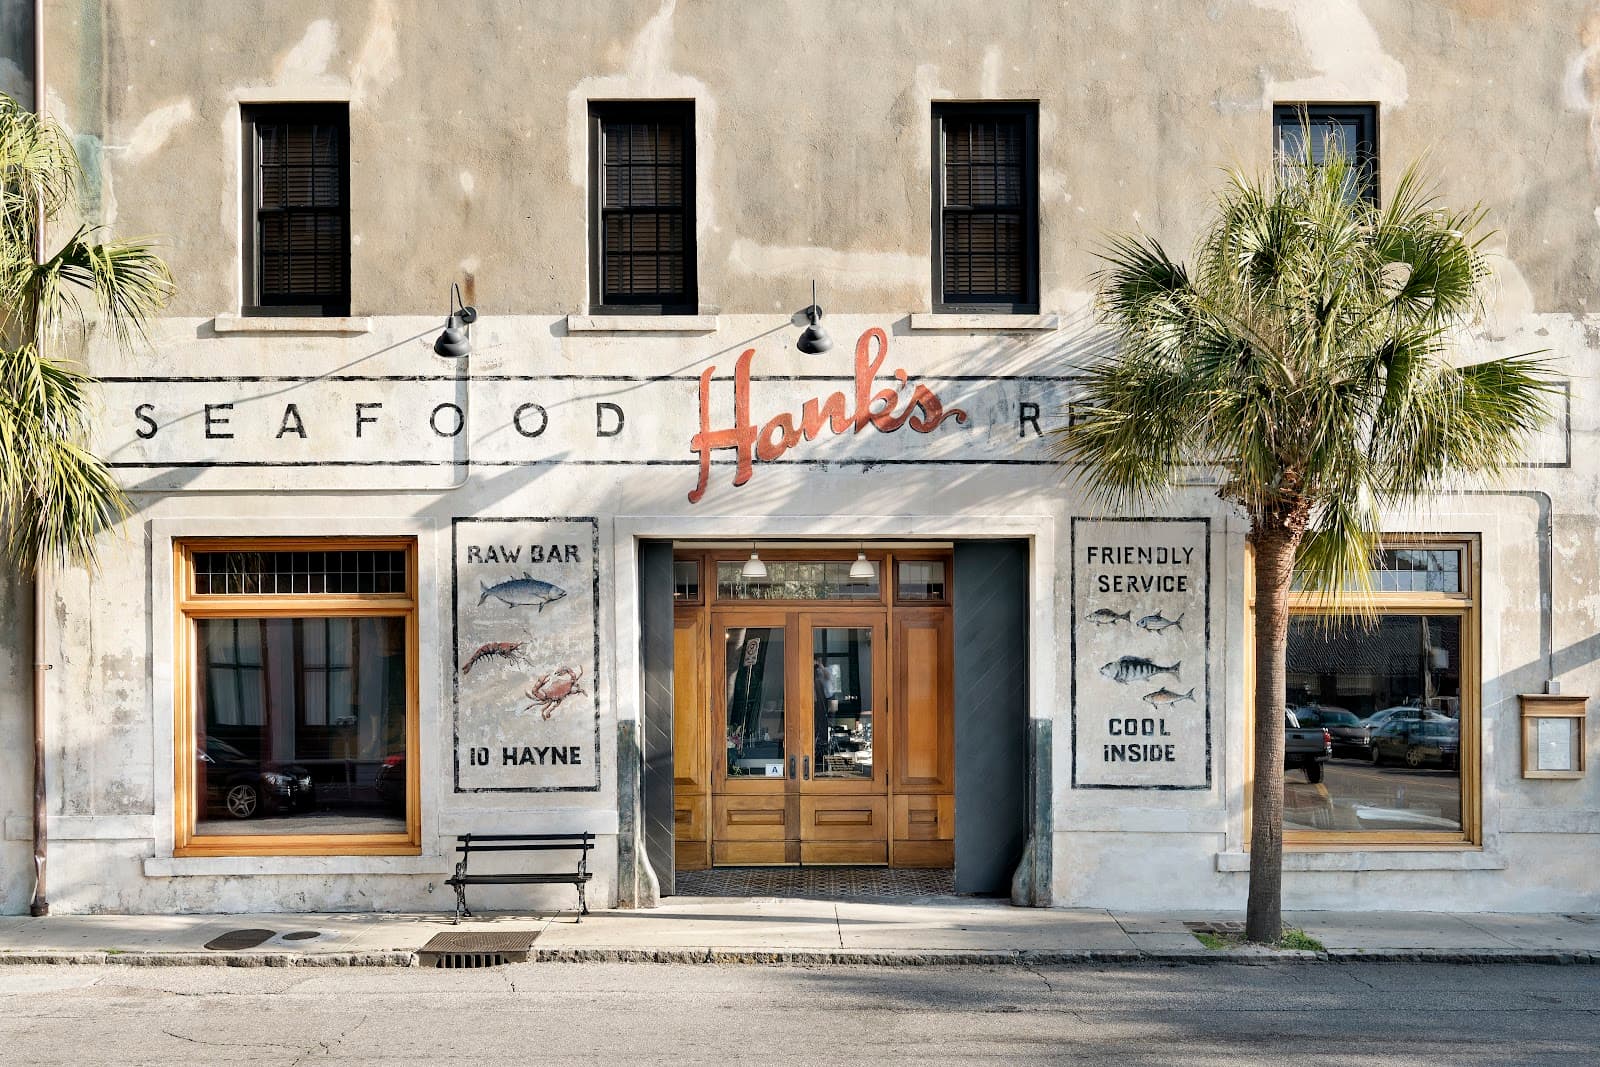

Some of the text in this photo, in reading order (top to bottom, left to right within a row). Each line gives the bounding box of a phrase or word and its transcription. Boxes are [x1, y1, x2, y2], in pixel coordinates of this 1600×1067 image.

[135, 402, 625, 439] SEAFOOD
[687, 327, 966, 504] Hank's
[467, 545, 581, 564] RAW BAR
[1087, 546, 1194, 564] FRIENDLY
[1098, 575, 1188, 593] SERVICE
[1109, 718, 1170, 736] COOL
[470, 746, 582, 765] 10 HAYNE
[1104, 744, 1176, 762] INSIDE
